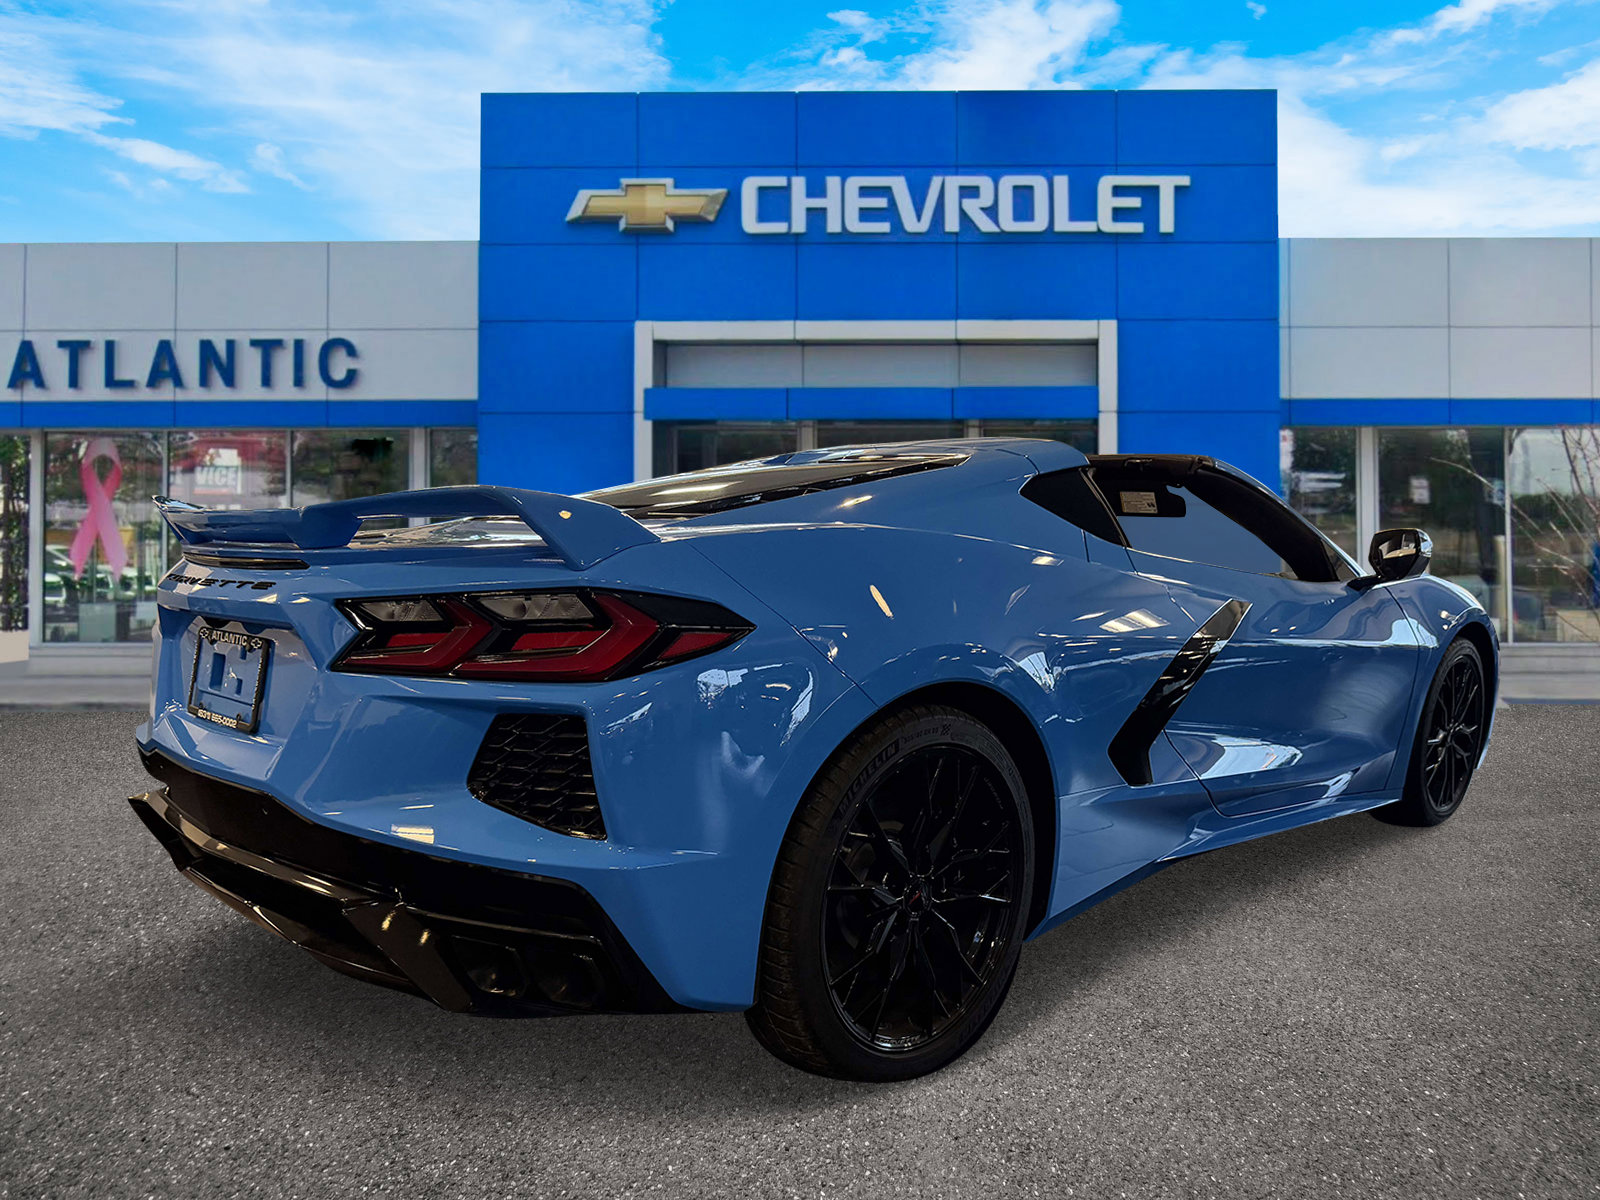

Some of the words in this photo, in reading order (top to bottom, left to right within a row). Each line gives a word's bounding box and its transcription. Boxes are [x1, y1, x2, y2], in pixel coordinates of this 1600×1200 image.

[741, 175, 1191, 234] CHEVROLET
[7, 337, 359, 389] ATLANTIC
[211, 630, 247, 646] ATLANTIC
